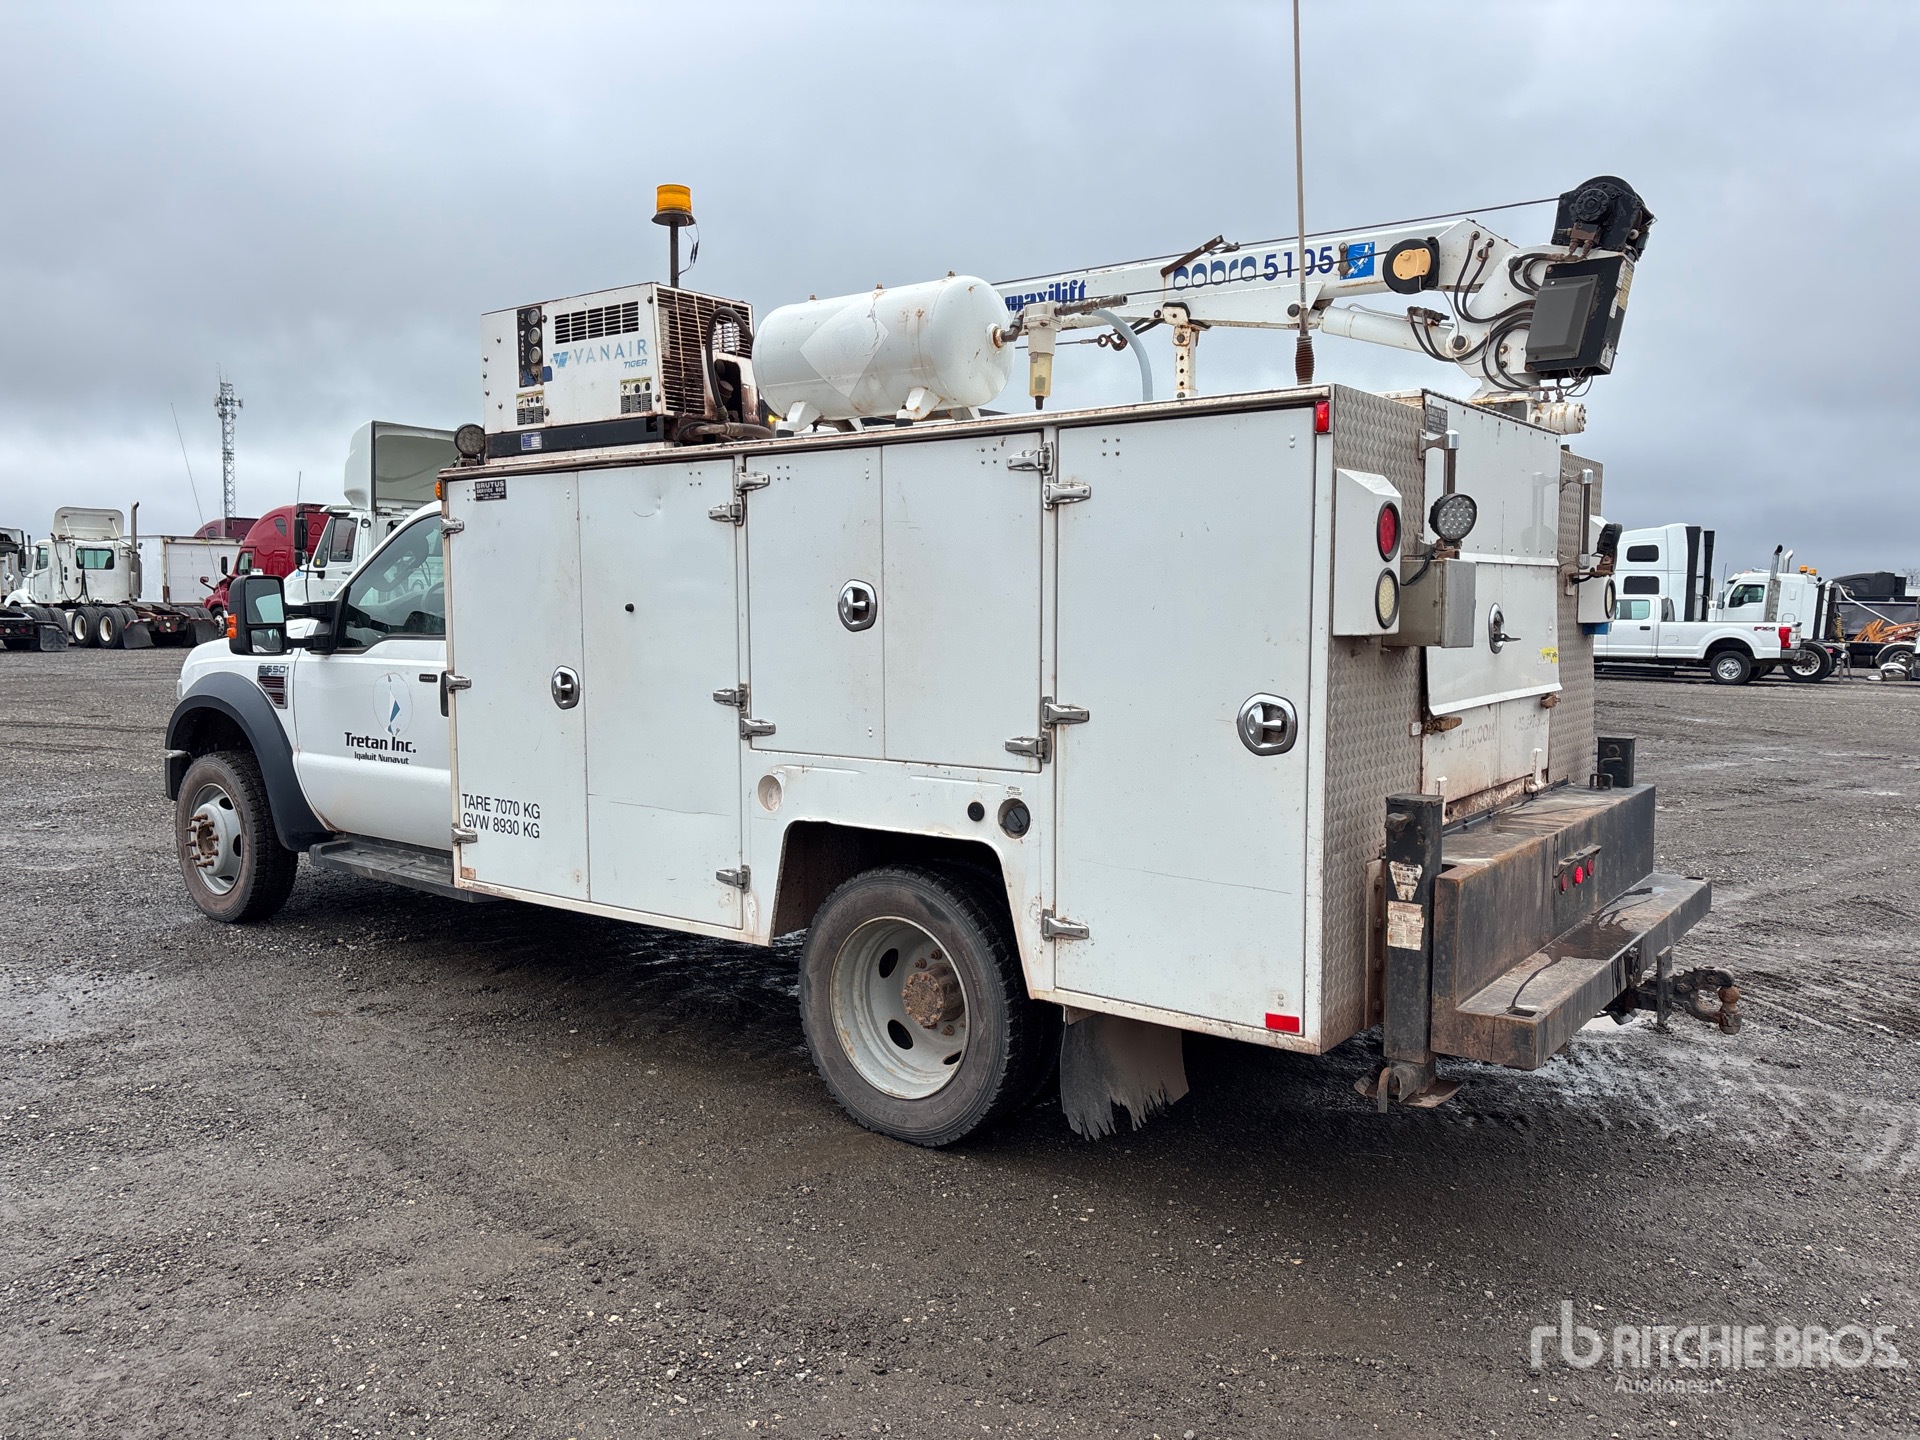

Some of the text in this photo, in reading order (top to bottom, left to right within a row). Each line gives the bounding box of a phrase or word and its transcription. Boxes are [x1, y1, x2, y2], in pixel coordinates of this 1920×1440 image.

[1005, 279, 1086, 311] maxilift
[573, 338, 648, 365] VANAIR
[624, 358, 648, 368] TIGER
[476, 480, 505, 489] BRUTUS
[344, 732, 417, 753] Tretan Inc.
[354, 751, 410, 765] Iqaluit Nunavut
[462, 793, 540, 819] TARE 7070 KG
[463, 812, 540, 838] GVW 8930 KG
